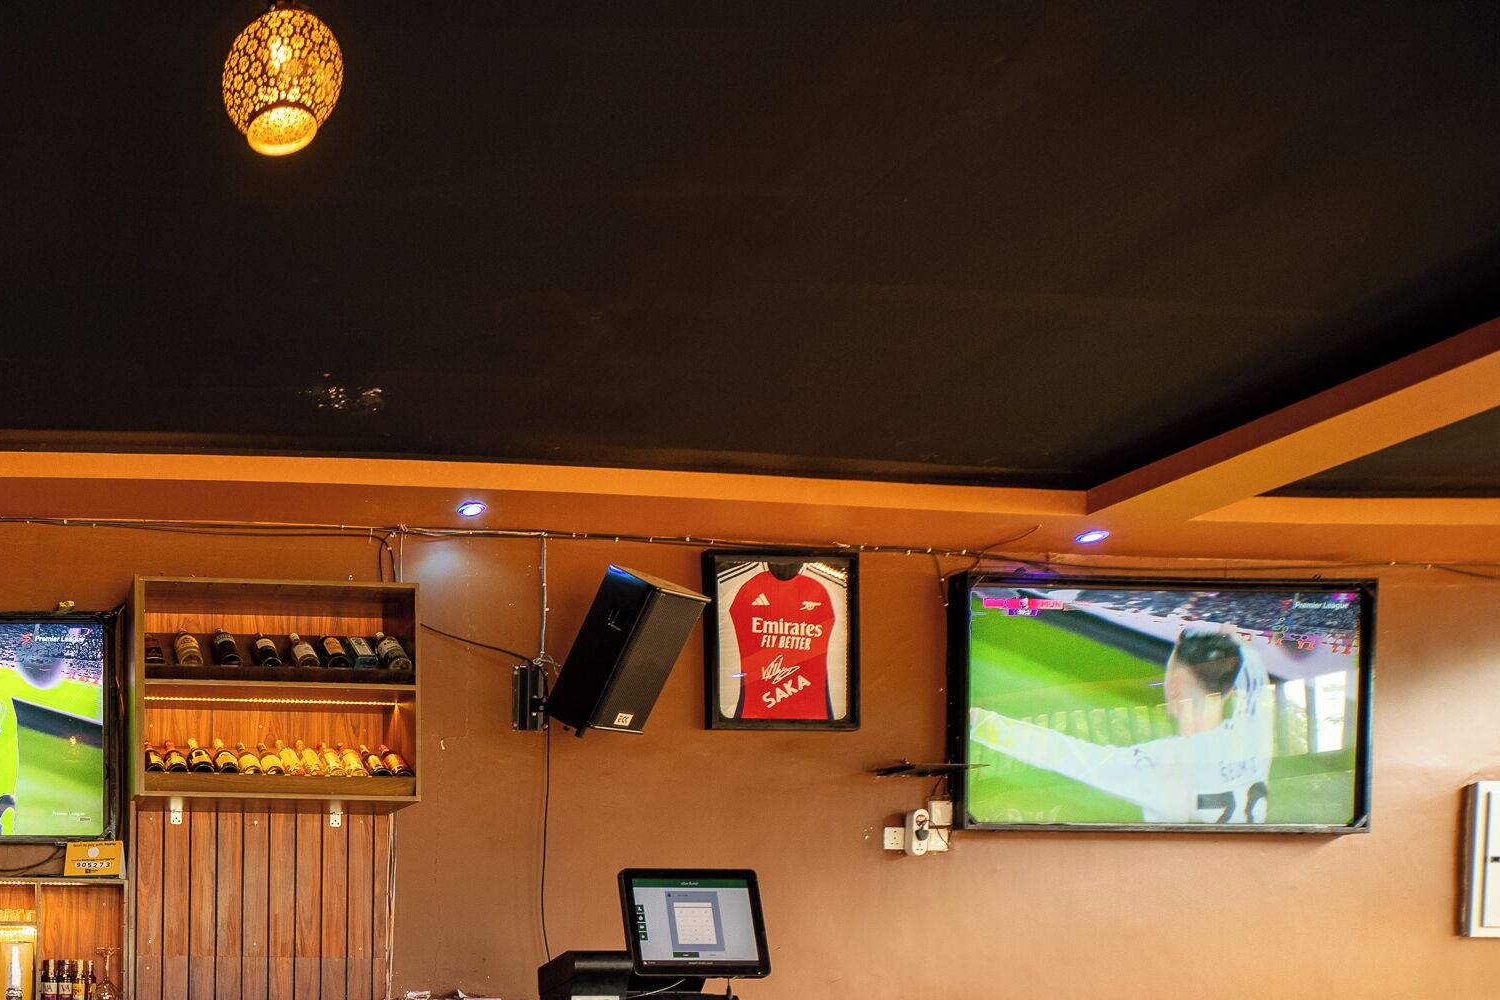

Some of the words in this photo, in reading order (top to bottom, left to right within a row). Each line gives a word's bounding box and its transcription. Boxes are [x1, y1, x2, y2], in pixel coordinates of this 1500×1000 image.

[1295, 601, 1322, 609] Premier
[1323, 601, 1350, 611] League
[752, 617, 823, 637] Emirates
[761, 634, 778, 648] FLY
[778, 635, 812, 651] BETTER
[762, 674, 812, 709] SAKA
